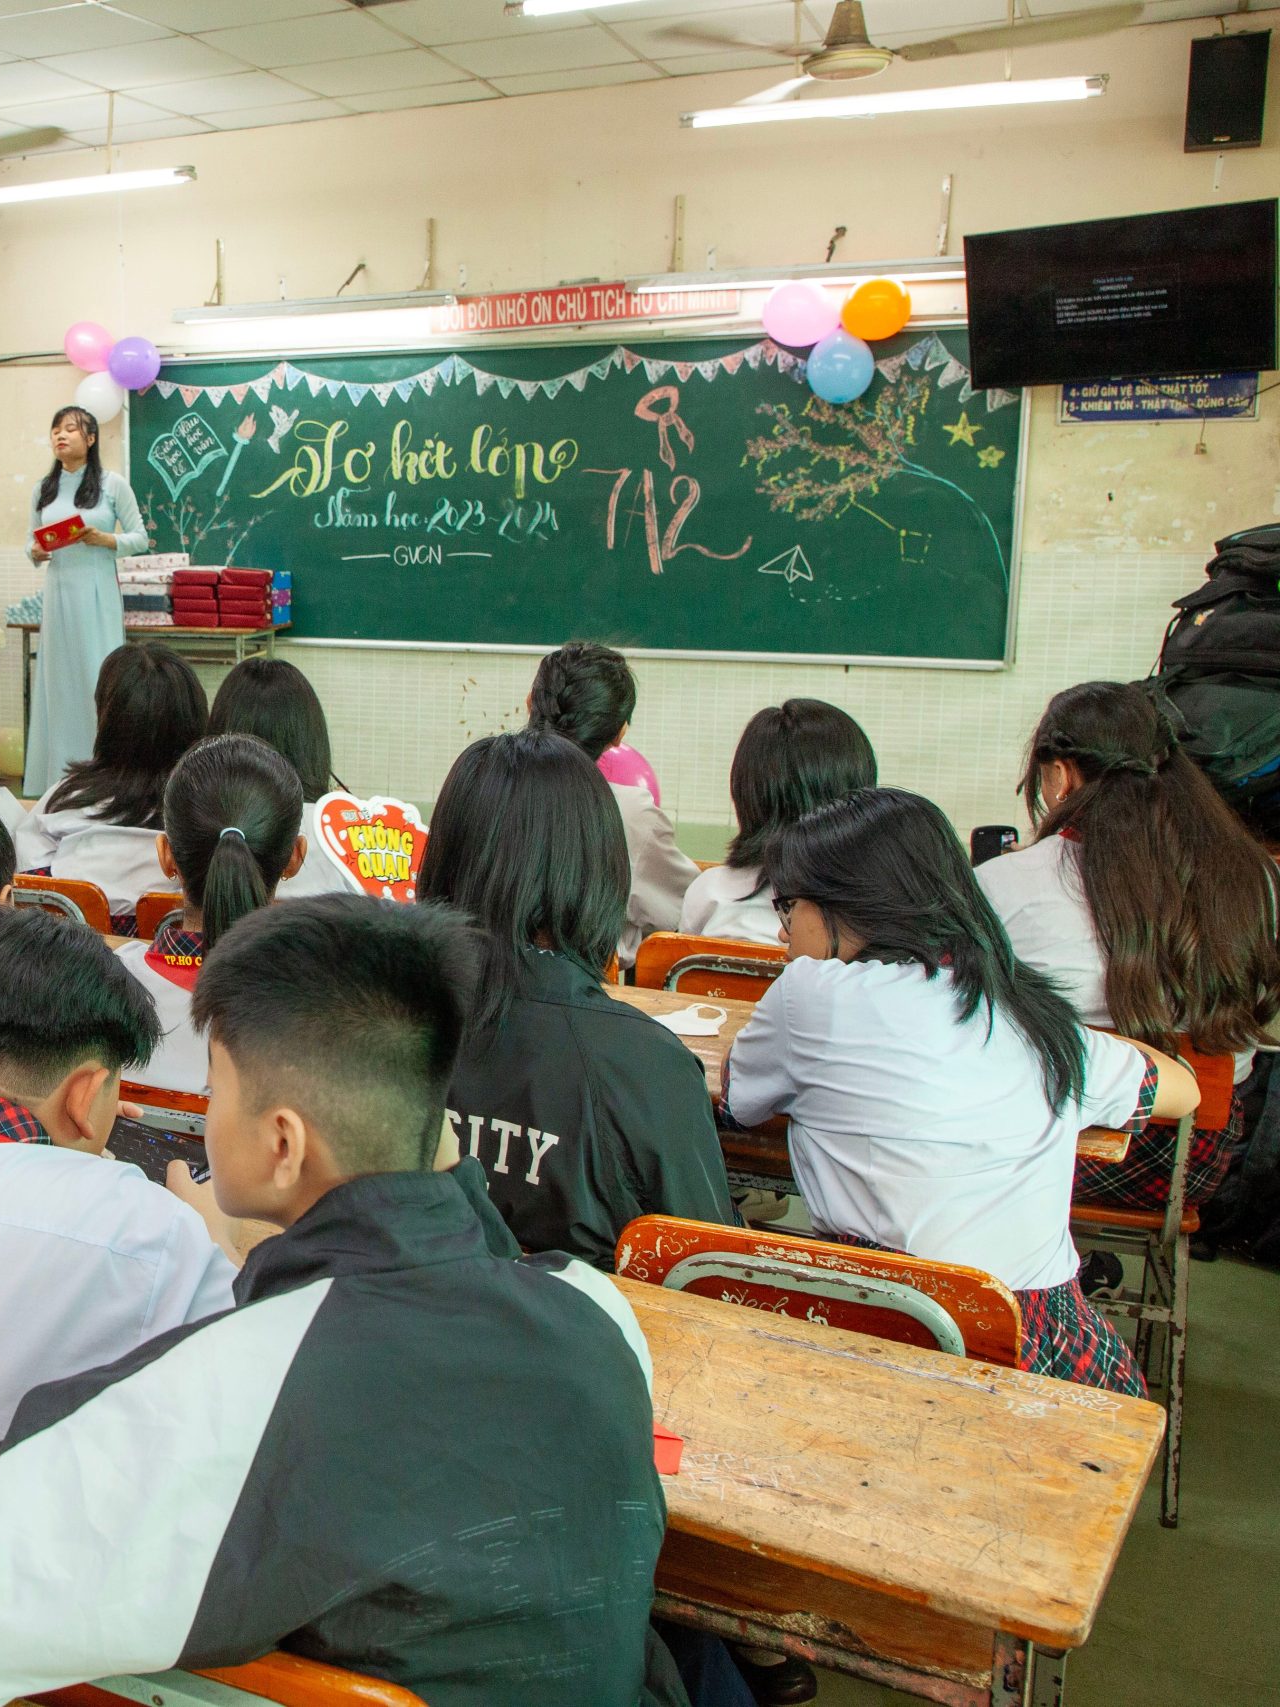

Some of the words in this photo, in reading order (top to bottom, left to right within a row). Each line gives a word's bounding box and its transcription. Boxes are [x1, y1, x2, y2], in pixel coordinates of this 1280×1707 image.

[556, 287, 587, 321] CHỦ
[384, 419, 457, 485] kết
[393, 544, 442, 566] GVCN
[346, 818, 414, 856] KHÔNG
[357, 852, 410, 885] QUẠU
[444, 1108, 560, 1186] ITY
